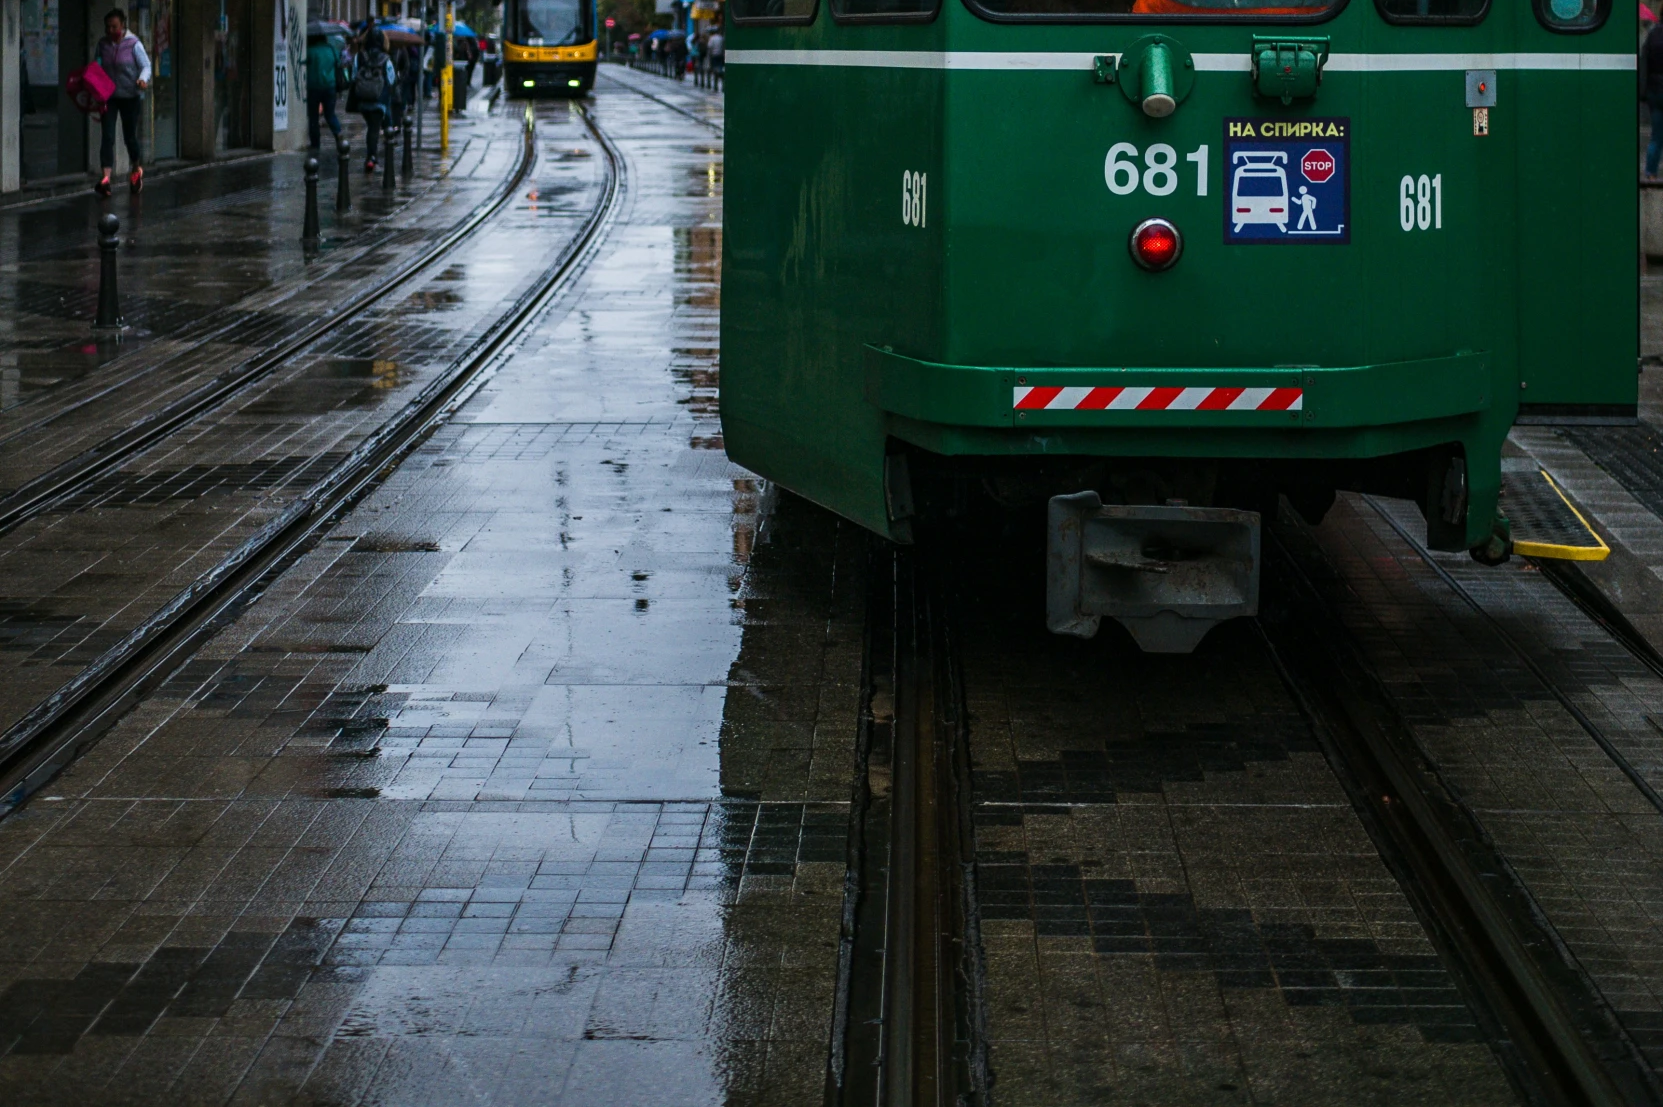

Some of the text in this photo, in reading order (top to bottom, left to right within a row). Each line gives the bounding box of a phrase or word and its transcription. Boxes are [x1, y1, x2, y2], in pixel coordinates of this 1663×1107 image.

[1229, 122, 1345, 137] НА СПИРКА:
[1104, 142, 1209, 196] 681
[1304, 161, 1332, 171] STOP
[902, 169, 927, 228] 681
[1400, 173, 1442, 232] 681
